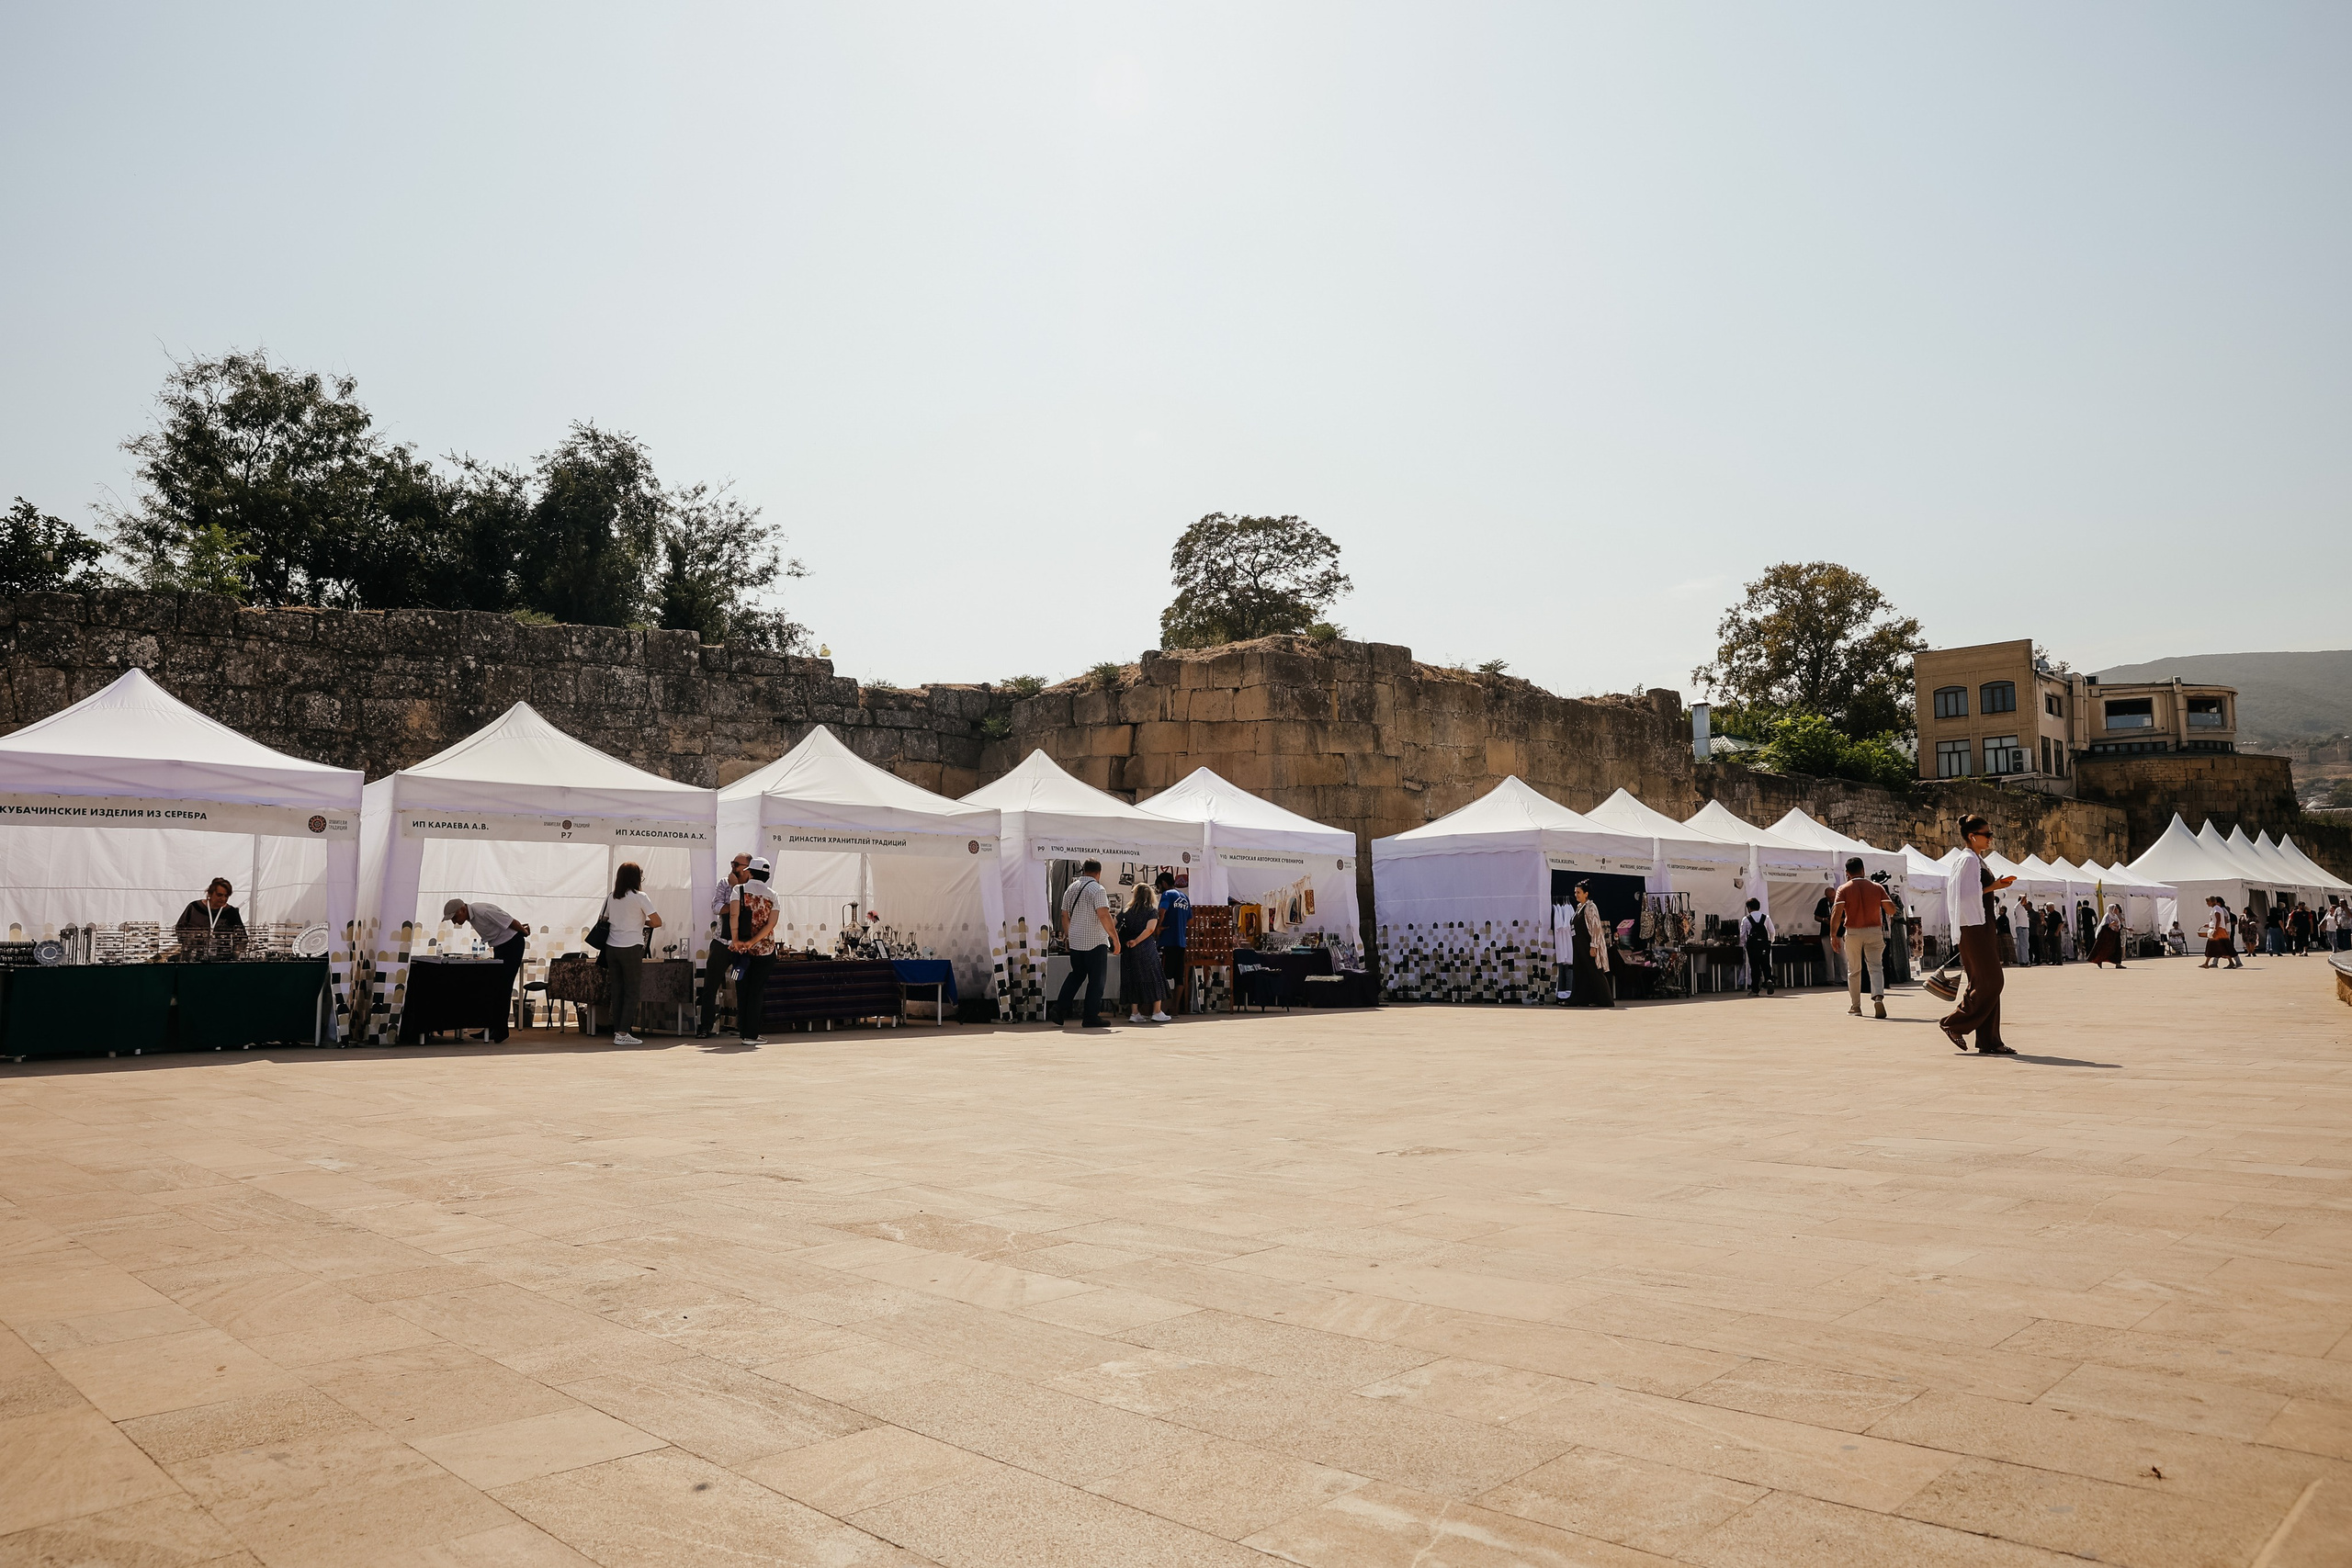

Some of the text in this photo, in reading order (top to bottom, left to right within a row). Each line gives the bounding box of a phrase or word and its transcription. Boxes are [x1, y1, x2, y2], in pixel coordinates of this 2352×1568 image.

[0, 806, 208, 820] КУБАЧИНСКИЕ ИЗДЕЛИЯ ИЗ СЕРЕБРА
[412, 820, 490, 830] ИП КАРАЕВА А.В.
[629, 829, 689, 839] ХАСБОЛАТОВА
[788, 835, 827, 843] ДИНАСТИЯ
[828, 836, 871, 845] ХРАНИТЕЛЕЙ
[872, 839, 907, 847] ТРАДИЦИЙ
[1051, 845, 1140, 857] ETNO_MASTERSKAYA_KARAKHANOVA
